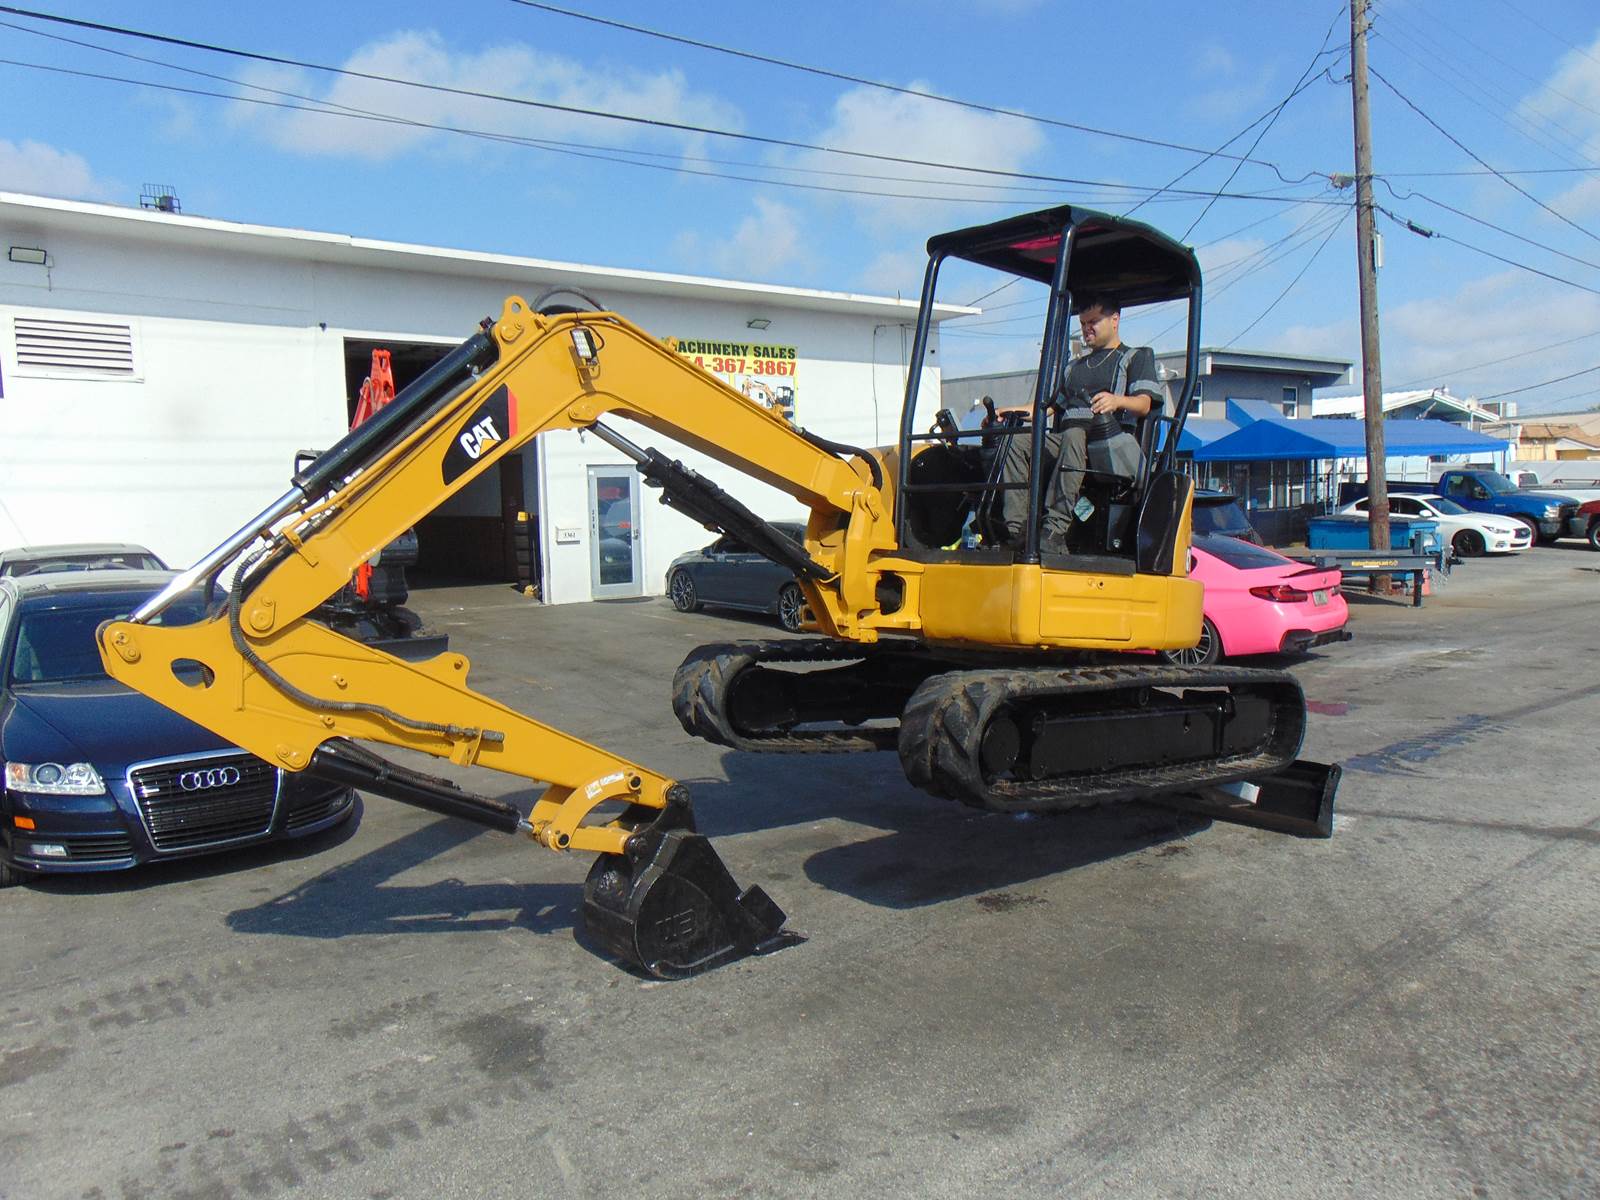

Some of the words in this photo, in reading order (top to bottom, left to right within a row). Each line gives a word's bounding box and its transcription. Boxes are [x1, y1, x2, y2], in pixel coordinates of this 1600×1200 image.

[676, 340, 749, 358] ACHINERY
[753, 346, 796, 360] SALES
[682, 356, 796, 376] 4-367-3867
[460, 416, 502, 459] CAT
